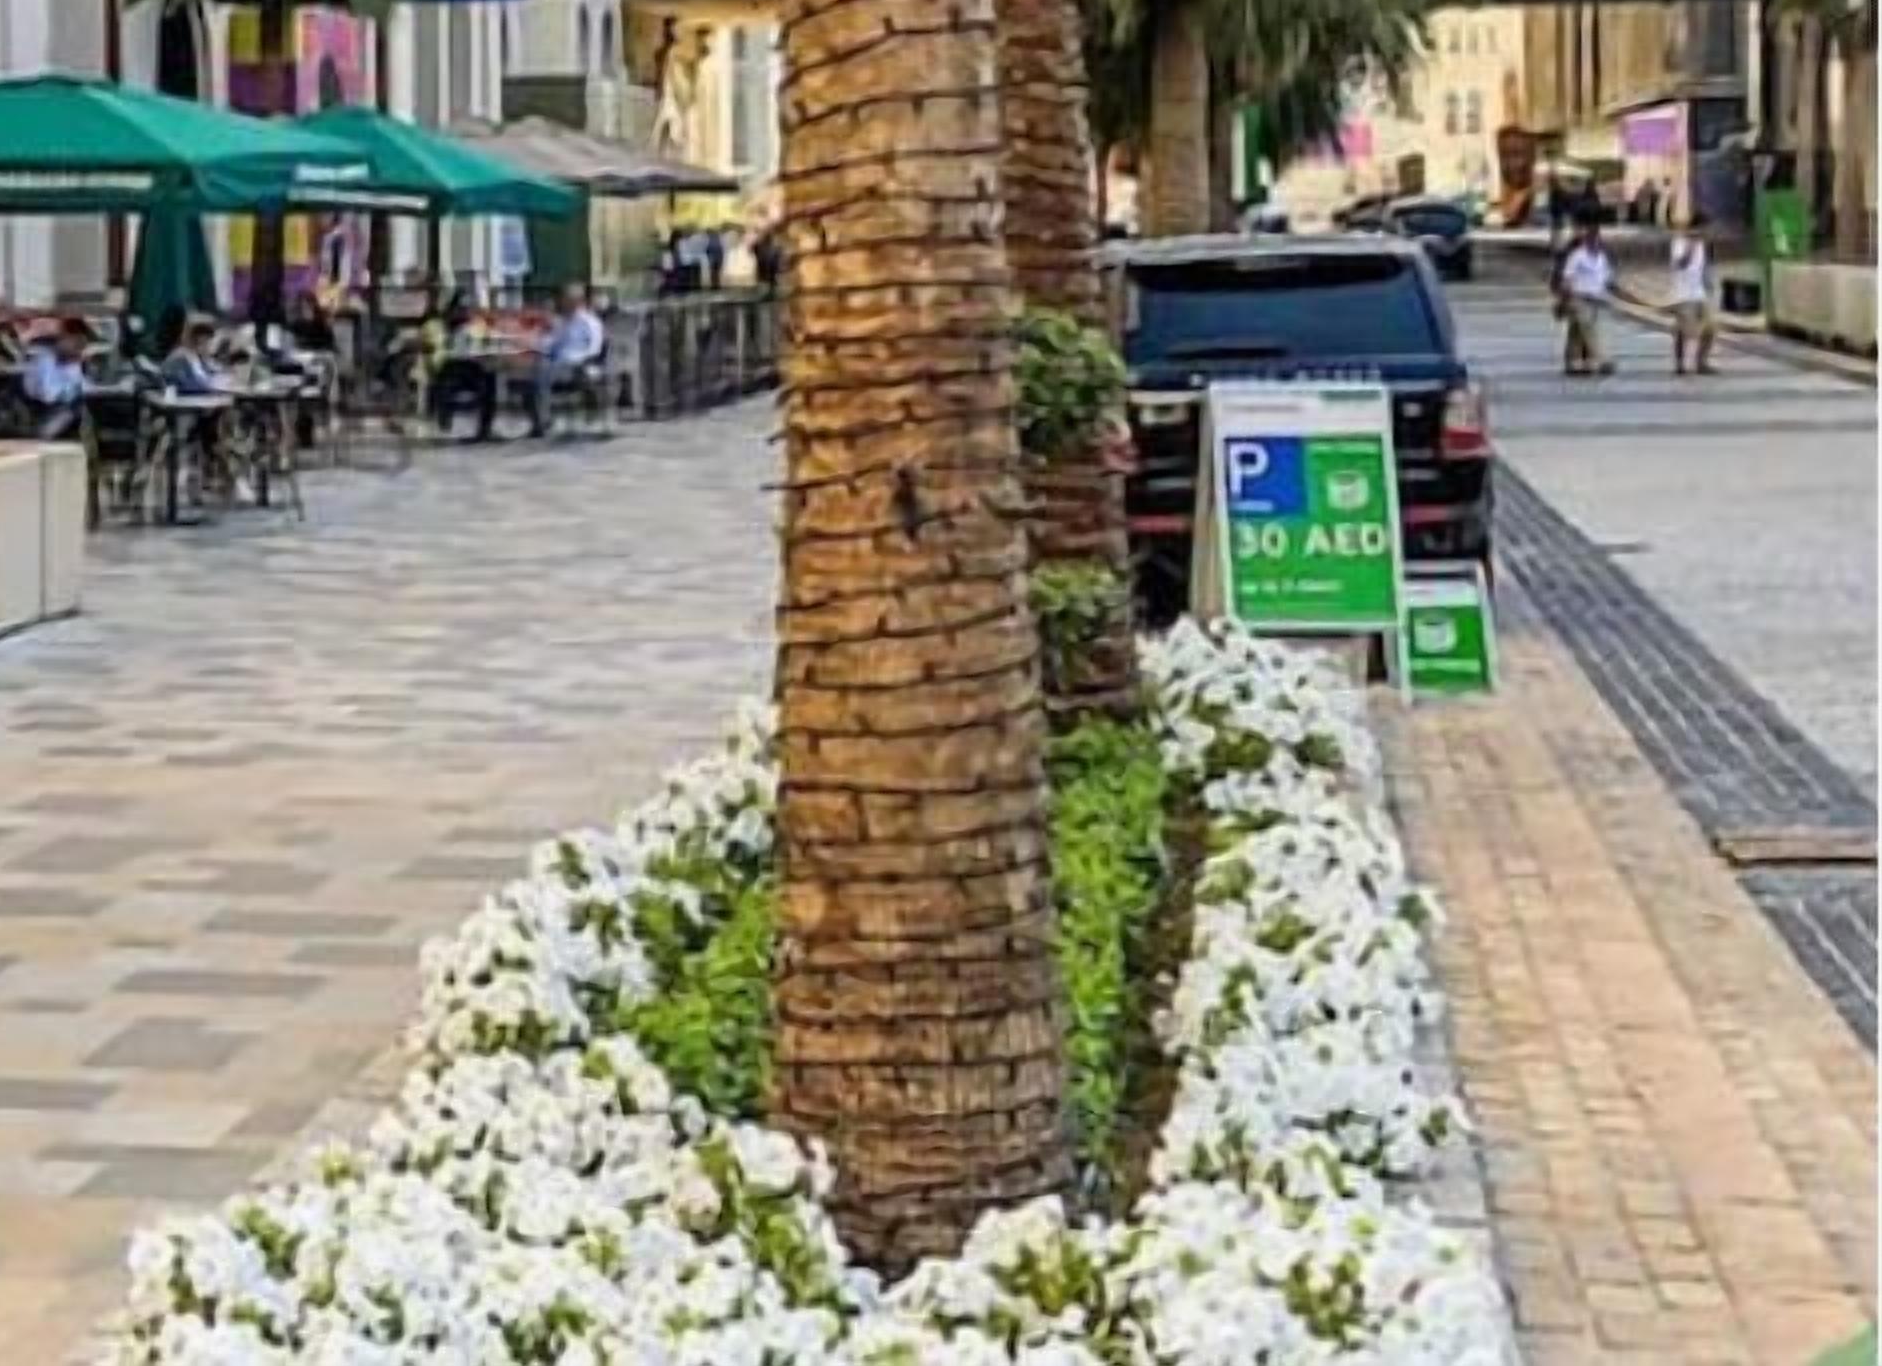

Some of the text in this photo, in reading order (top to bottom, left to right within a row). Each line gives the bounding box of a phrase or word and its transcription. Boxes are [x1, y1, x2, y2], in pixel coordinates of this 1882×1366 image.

[1229, 442, 1268, 496] P
[1235, 521, 1386, 559] 30 AED
